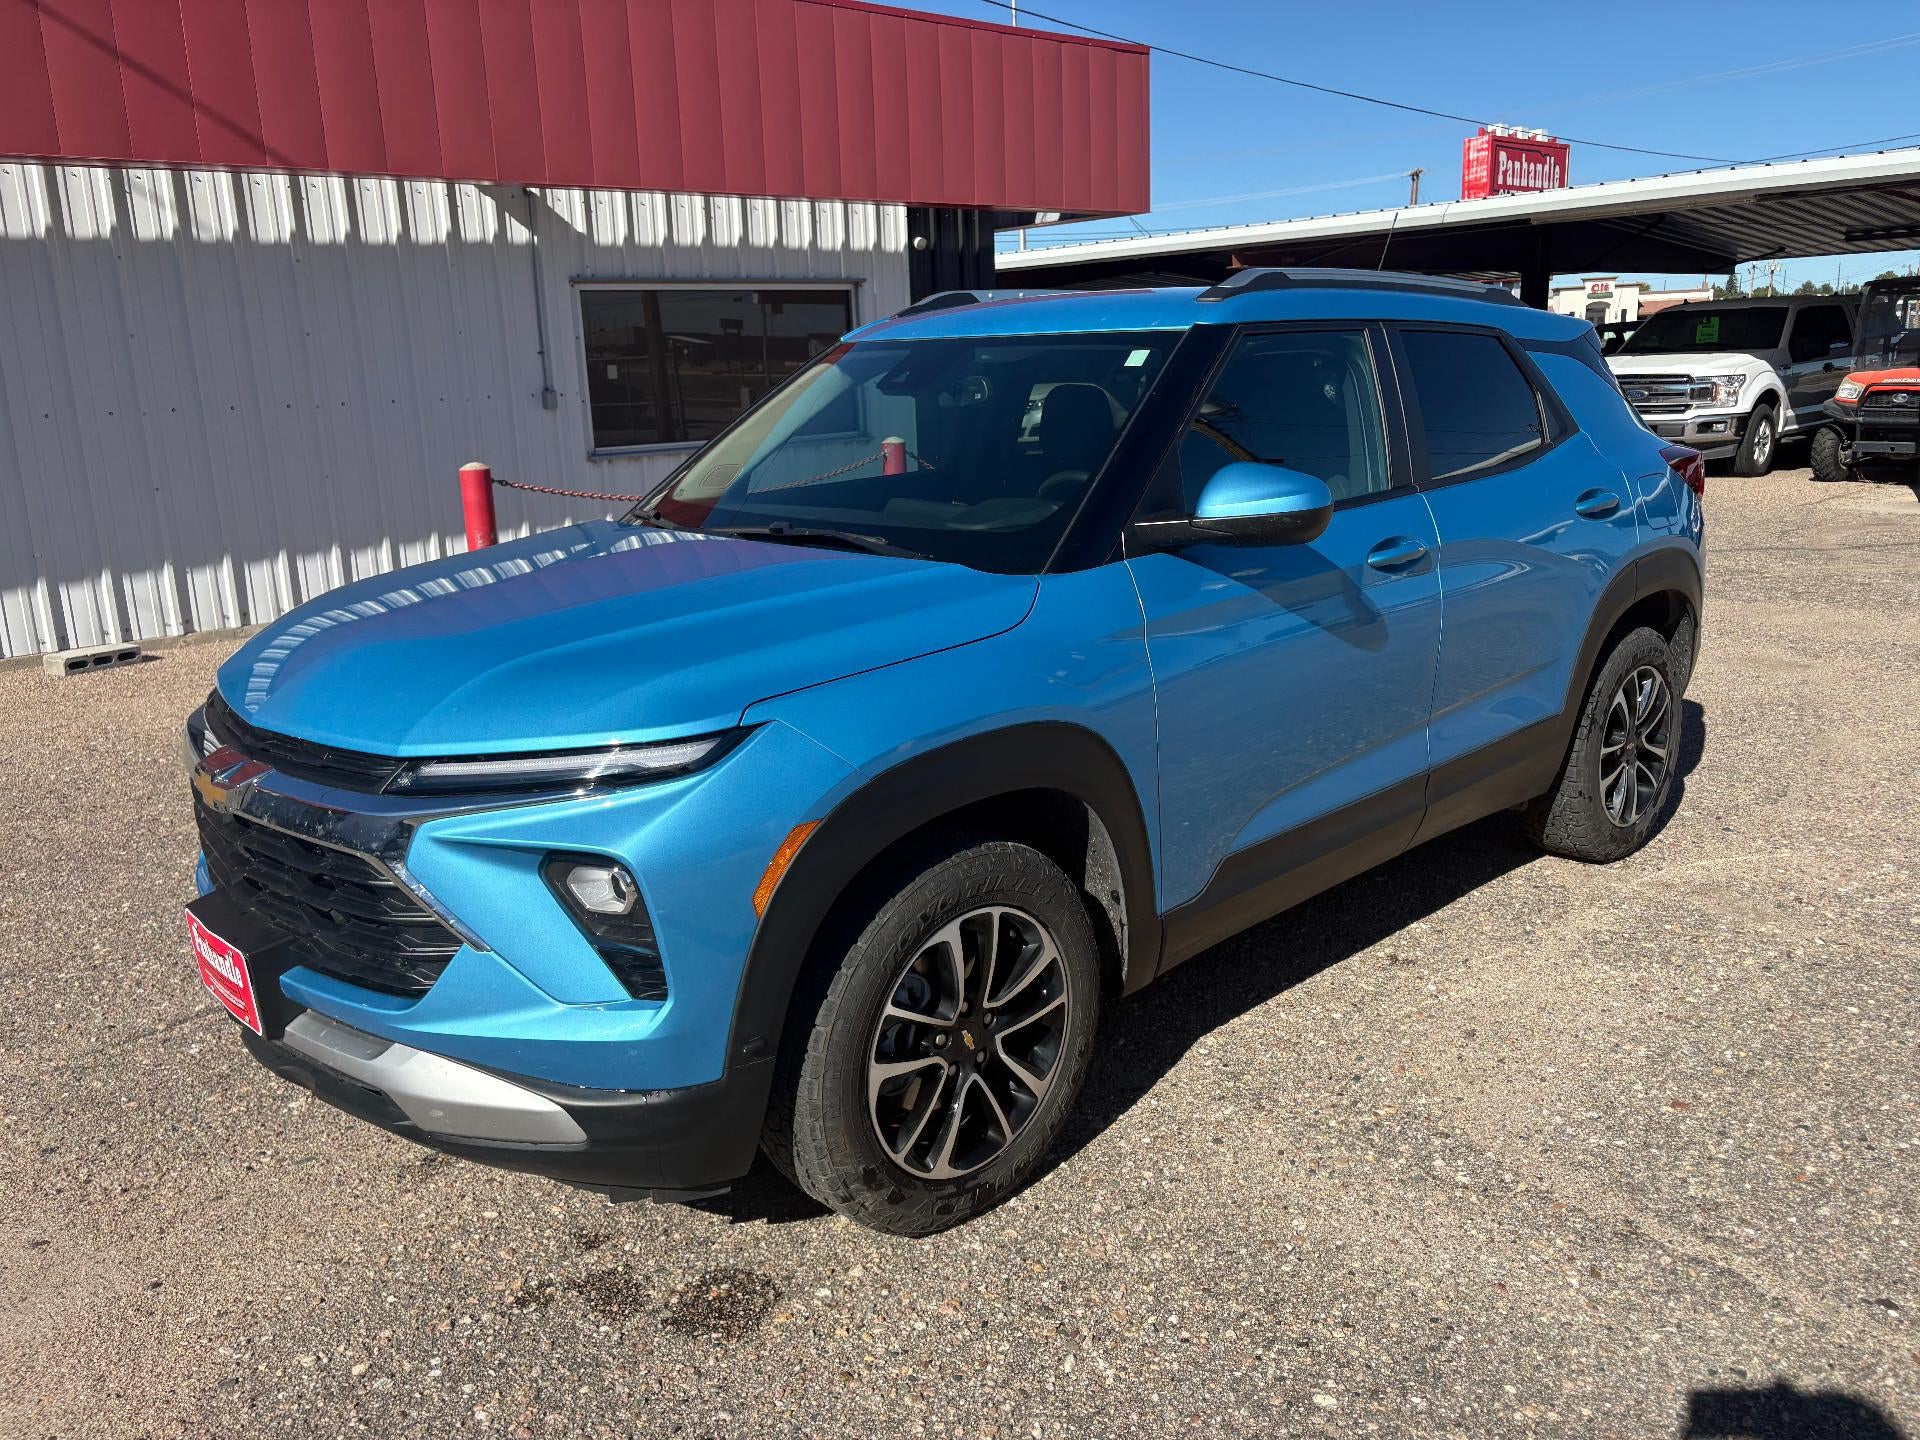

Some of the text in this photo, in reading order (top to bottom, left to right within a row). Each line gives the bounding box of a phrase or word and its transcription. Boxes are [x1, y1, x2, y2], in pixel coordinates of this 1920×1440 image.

[1497, 150, 1560, 189] Panhandle
[191, 923, 244, 989] Panhandle
[880, 885, 961, 974] TOYO
